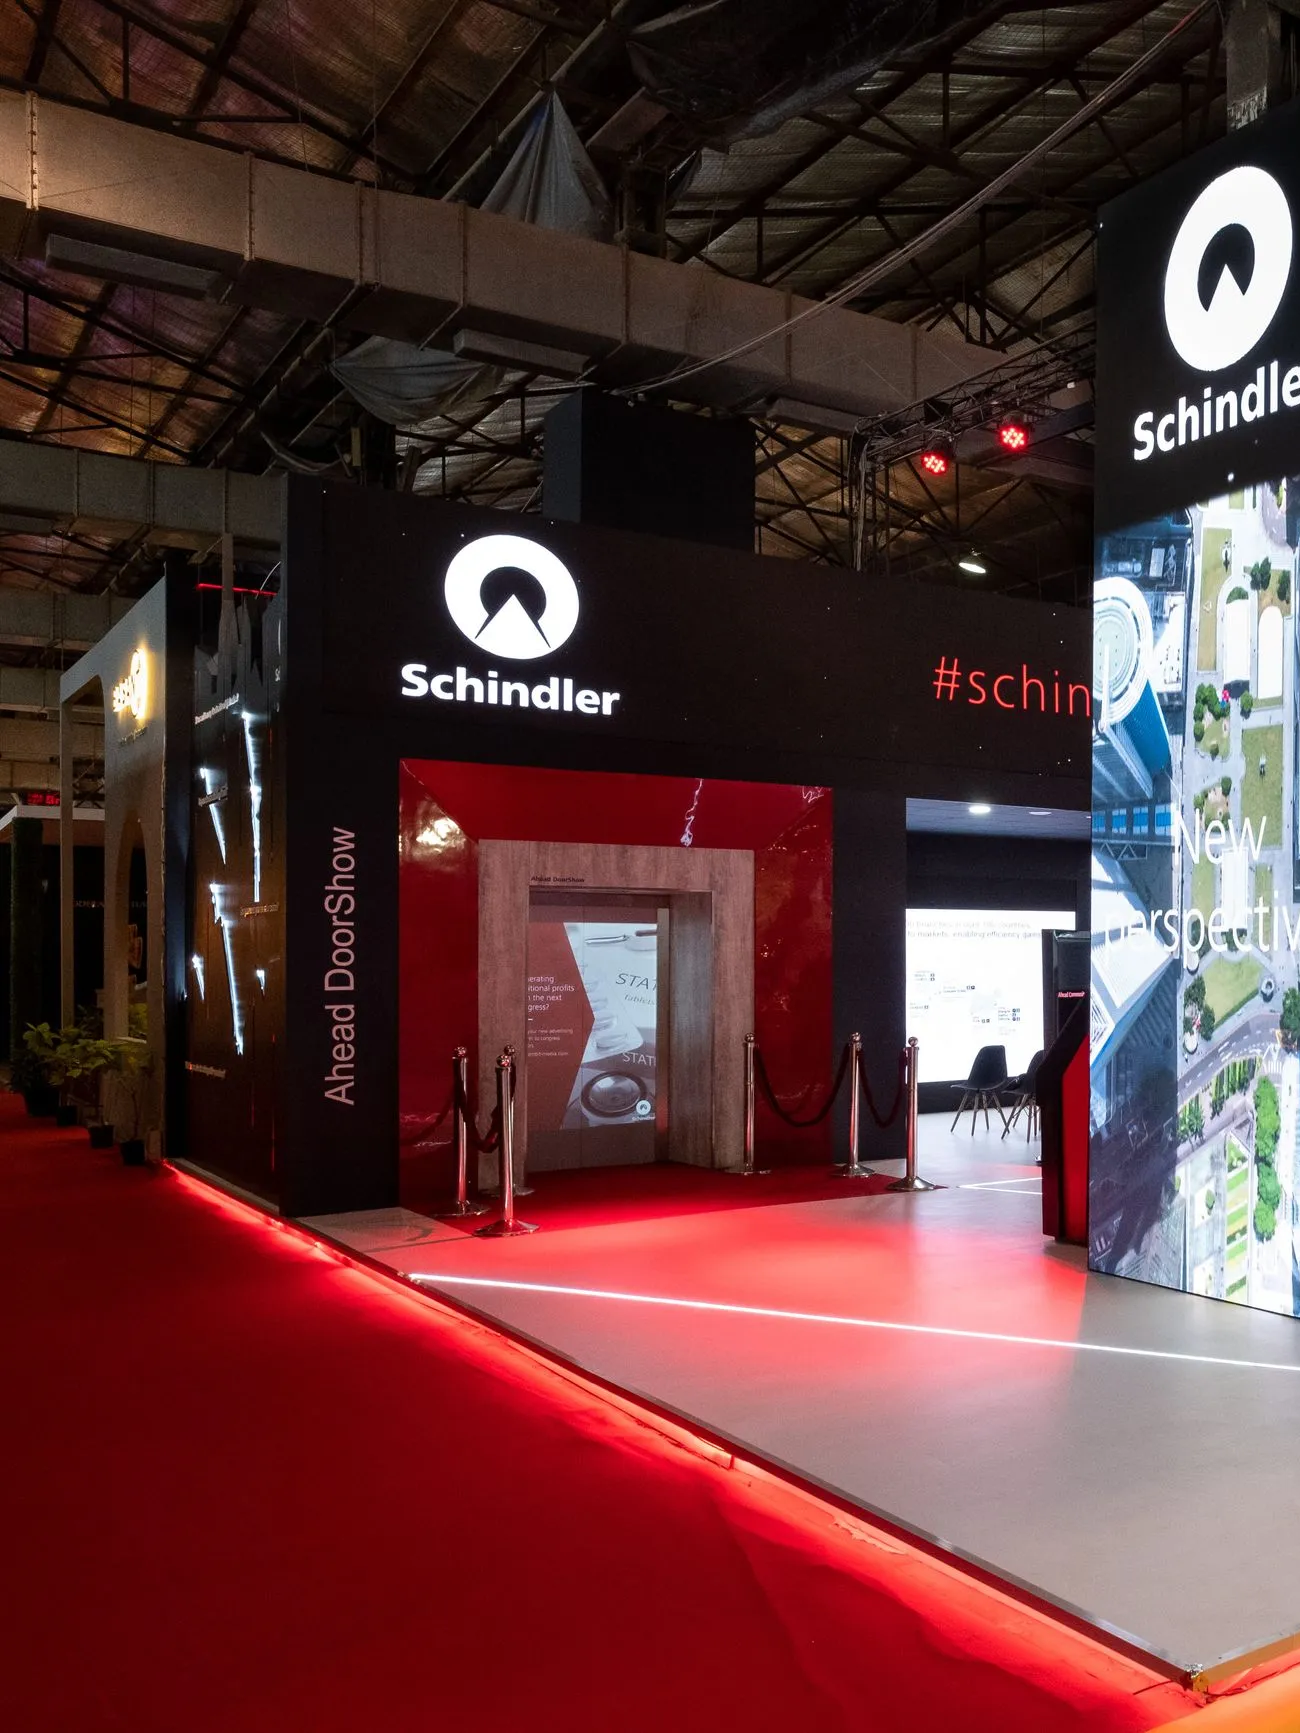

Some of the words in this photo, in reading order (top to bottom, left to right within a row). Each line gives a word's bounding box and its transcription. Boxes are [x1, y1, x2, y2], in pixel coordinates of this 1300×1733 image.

[400, 662, 620, 717] Schindler
[933, 654, 1091, 718] #schin
[1172, 806, 1267, 866] New
[324, 826, 355, 992] DoorShow
[324, 1003, 355, 1106] Ahead
